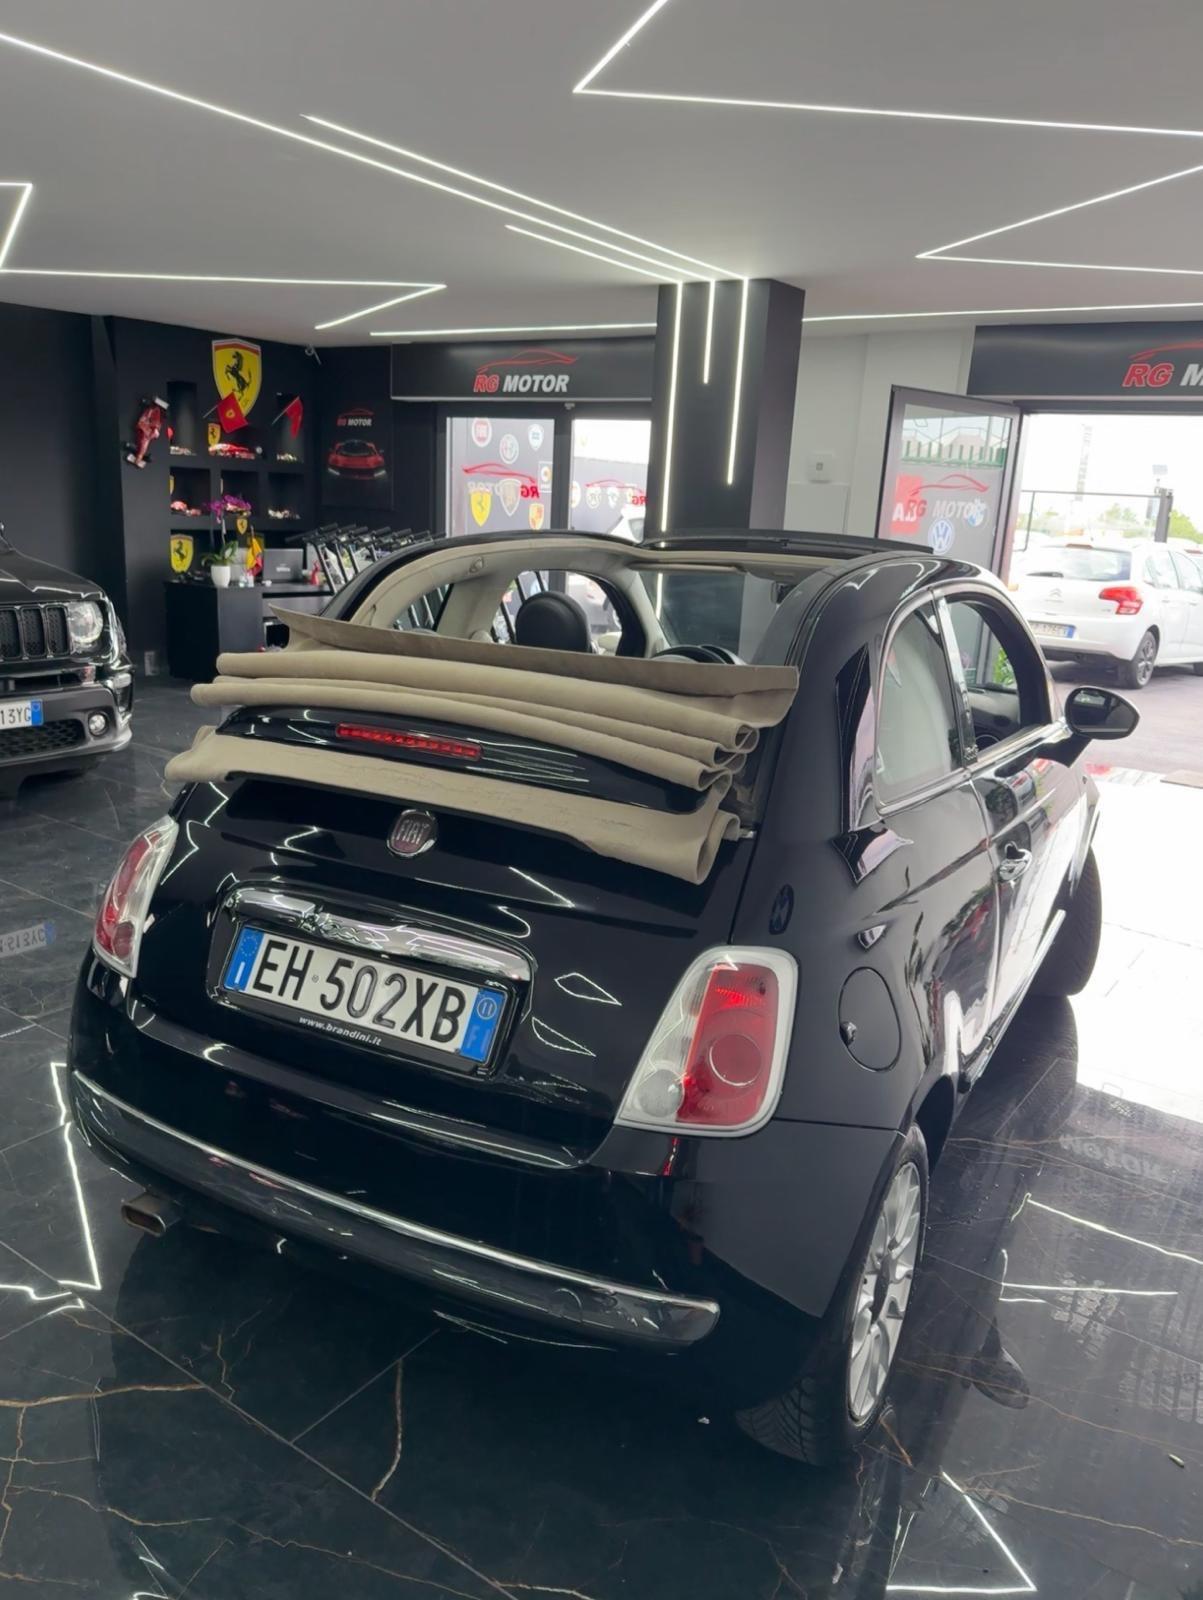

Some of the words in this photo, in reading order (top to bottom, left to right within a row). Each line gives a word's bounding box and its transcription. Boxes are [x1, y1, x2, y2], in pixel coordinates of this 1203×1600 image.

[473, 374, 500, 393] RG
[502, 374, 570, 393] MOTOR
[1122, 363, 1175, 387] RG
[347, 418, 372, 427] MOTOR
[396, 819, 430, 845] FIAT
[253, 939, 315, 1001] EH
[320, 957, 467, 1044] 502XB
[299, 1017, 382, 1046] www.brandini.it
